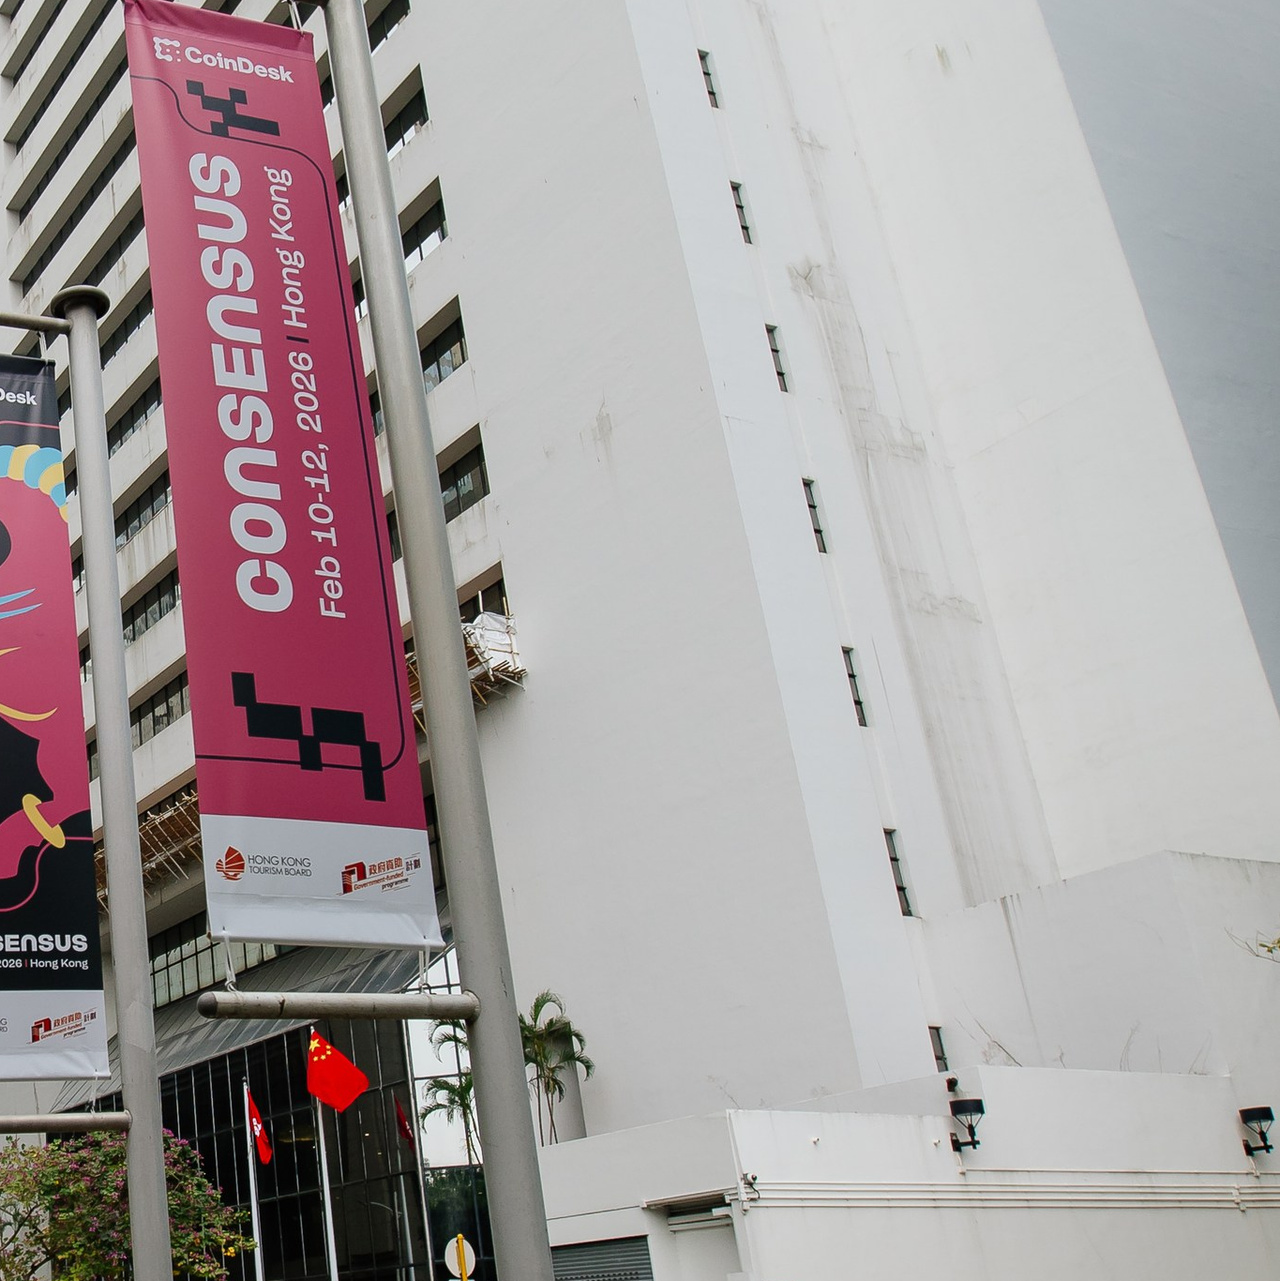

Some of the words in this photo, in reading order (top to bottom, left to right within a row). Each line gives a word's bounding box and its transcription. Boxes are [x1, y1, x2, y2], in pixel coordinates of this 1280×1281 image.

[184, 46, 294, 84] CoinDesk
[263, 165, 296, 242] Kong
[275, 247, 308, 329] Hong
[288, 351, 323, 434] 2026
[300, 443, 338, 547] 10-12,
[314, 556, 347, 619] Feb
[247, 854, 280, 867] HONG
[280, 856, 312, 868] KONG
[248, 865, 283, 876] TOURISM
[284, 867, 313, 878] BOARD
[381, 877, 409, 891] programme
[30, 959, 59, 971] Hong
[60, 959, 89, 971] Kong
